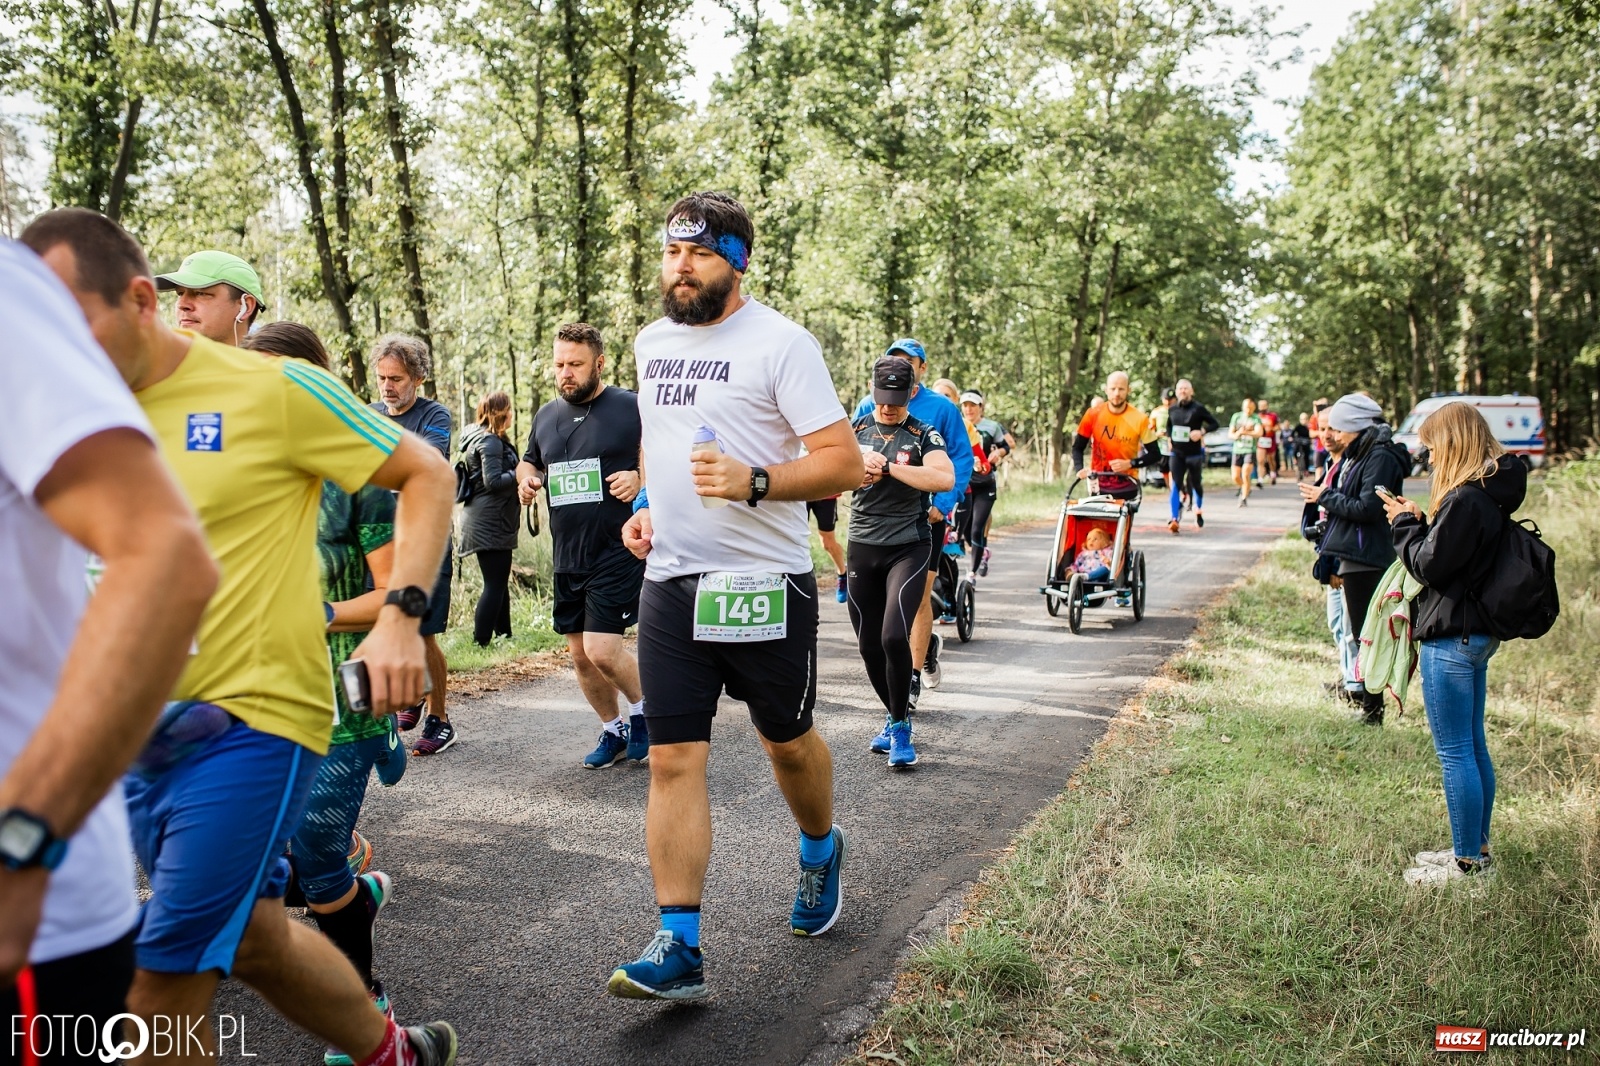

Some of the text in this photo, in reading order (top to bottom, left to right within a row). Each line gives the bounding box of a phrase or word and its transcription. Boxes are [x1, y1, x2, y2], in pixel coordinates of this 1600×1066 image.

[644, 359, 731, 383] NOWA HUTA
[655, 384, 698, 406] TEAM
[557, 473, 590, 494] 160
[726, 575, 733, 590] V
[714, 595, 771, 624] 149
